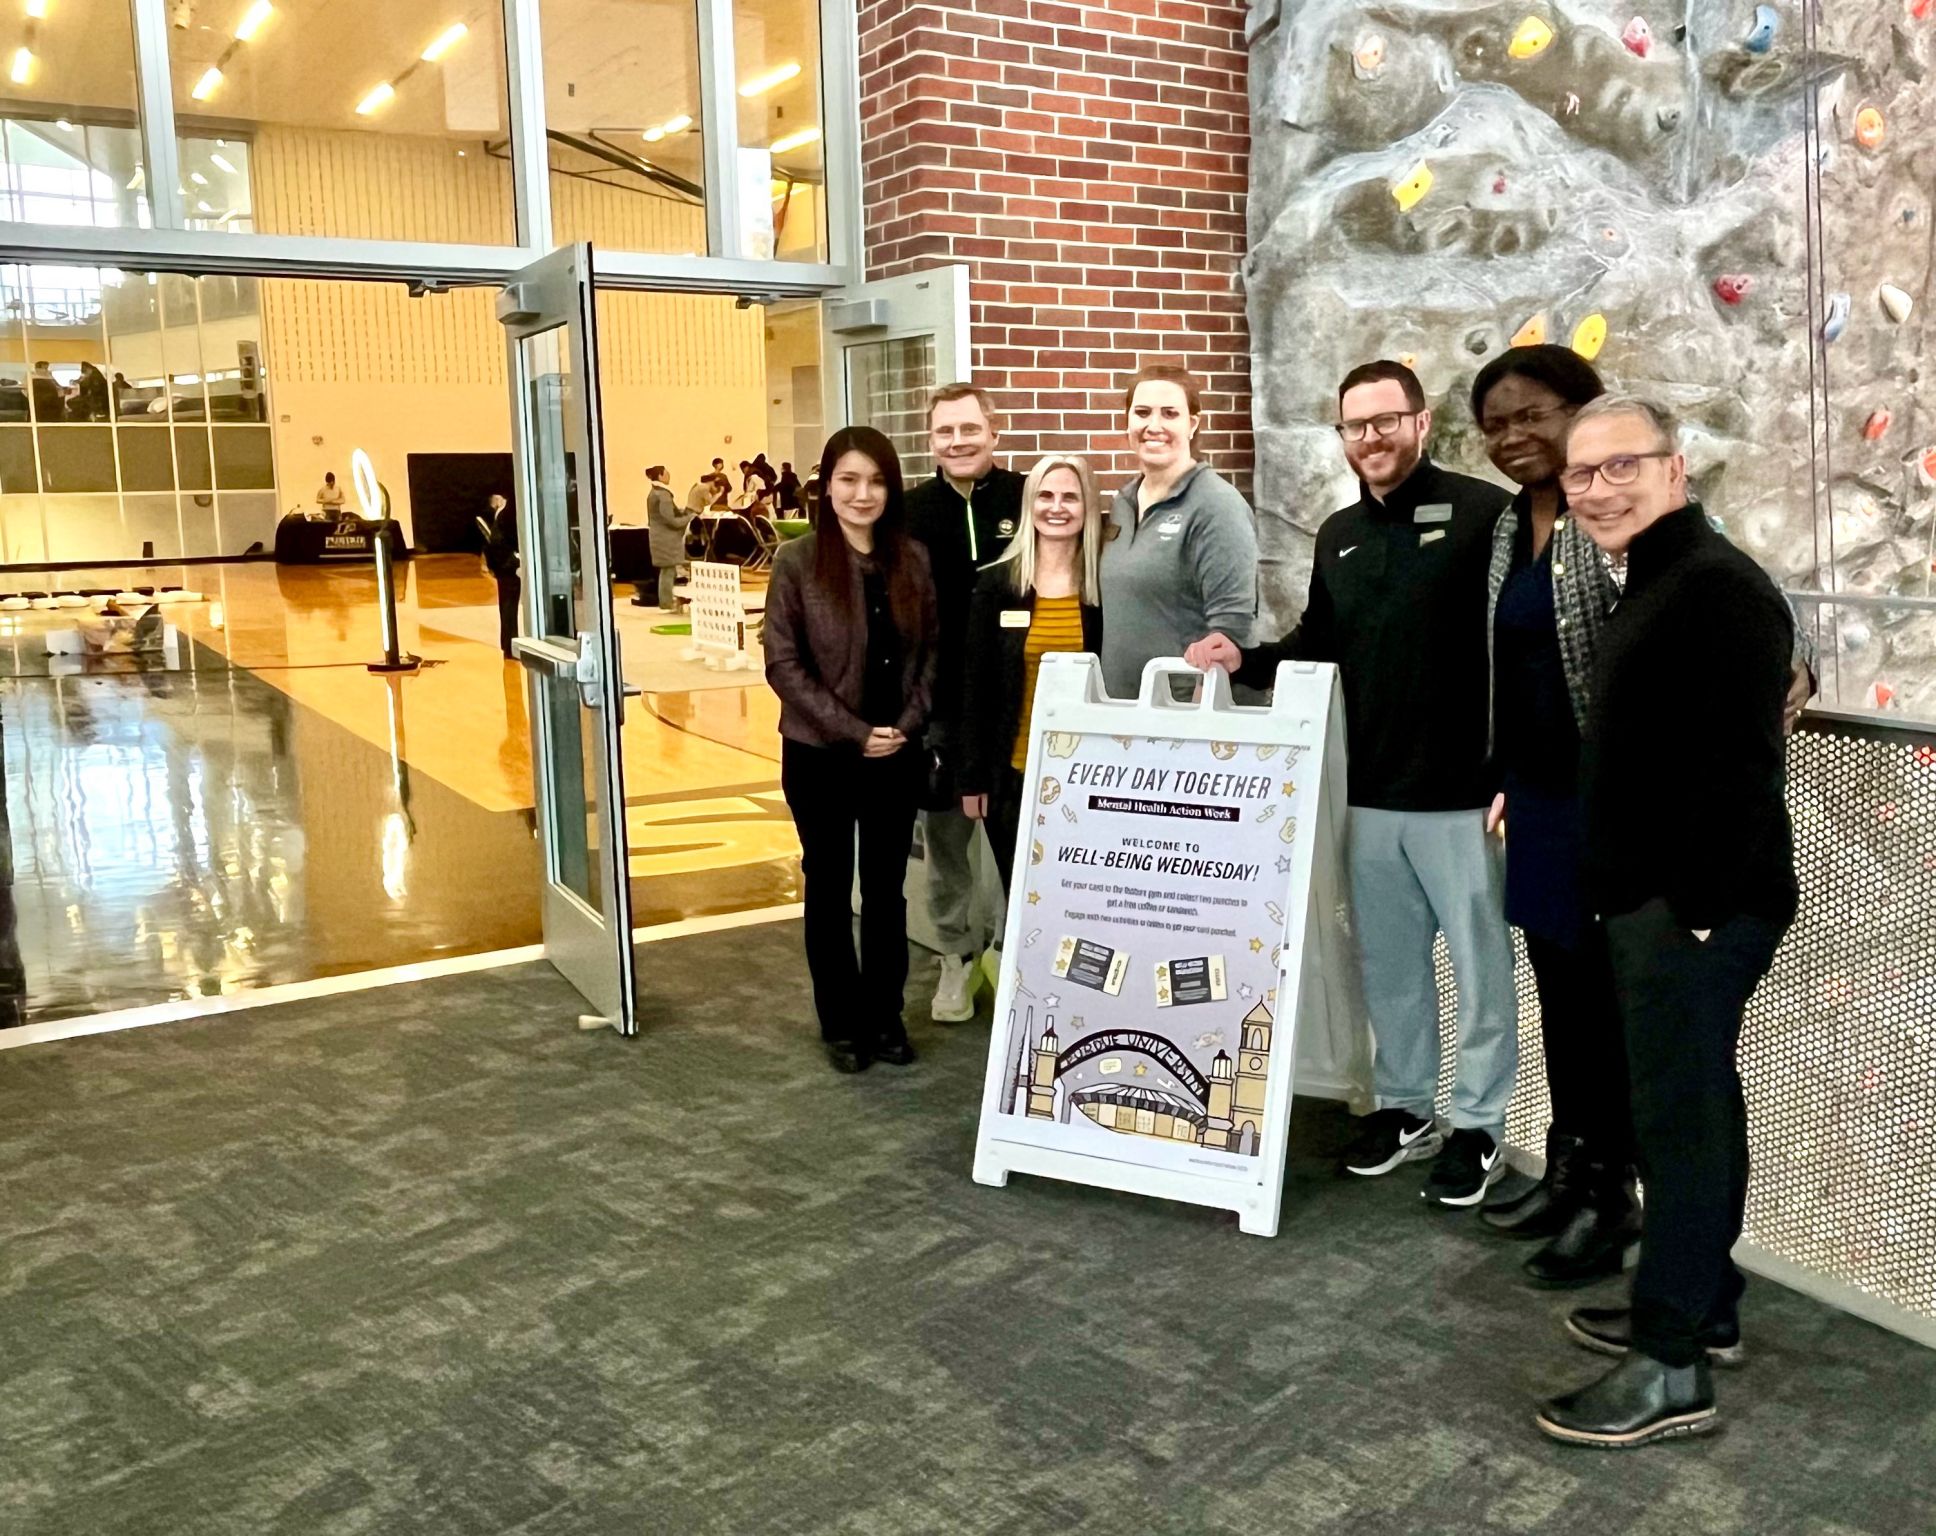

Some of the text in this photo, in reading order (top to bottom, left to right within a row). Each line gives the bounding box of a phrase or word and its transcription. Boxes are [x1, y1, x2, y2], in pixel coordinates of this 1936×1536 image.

[1067, 762, 1271, 799] EVERY DAY TOGETHER
[1097, 798, 1132, 811] Mental
[1134, 802, 1167, 815] Health
[1169, 806, 1202, 817] Action
[1122, 838, 1200, 853] WELCOME TO
[1058, 846, 1260, 882] WELL-BEING WEDNESDAY!
